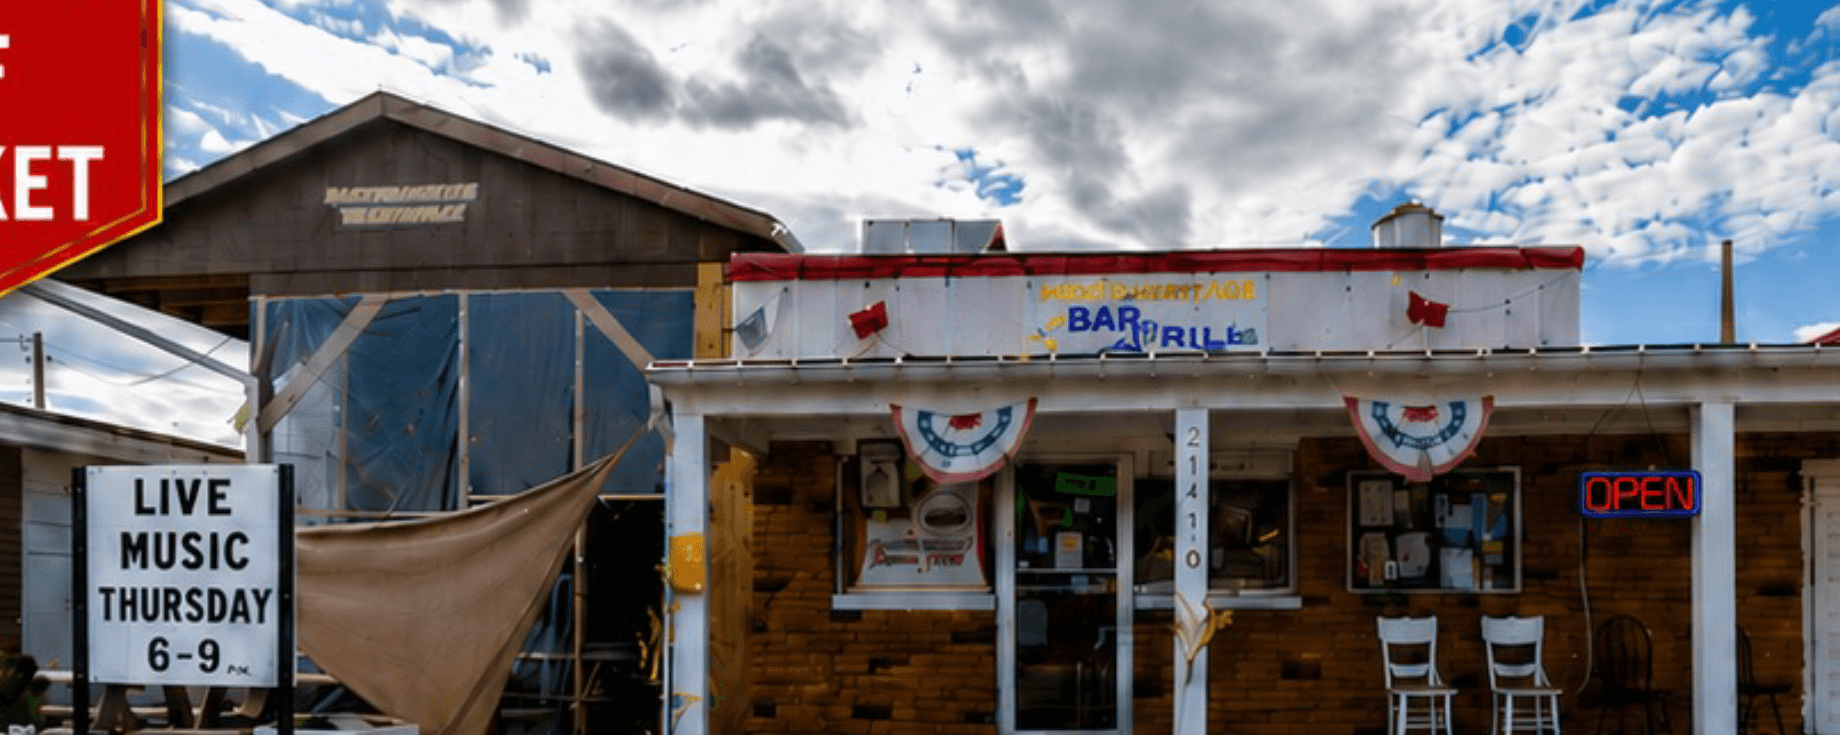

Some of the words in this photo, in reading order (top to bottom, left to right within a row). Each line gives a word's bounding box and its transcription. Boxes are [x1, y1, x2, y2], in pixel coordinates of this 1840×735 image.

[1068, 304, 1141, 332] BAR
[134, 478, 232, 516] LIVE
[1586, 476, 1693, 511] OPEN
[120, 531, 250, 571] MUSIC
[98, 586, 273, 625] THURSDAY
[148, 636, 220, 674] 6-9
